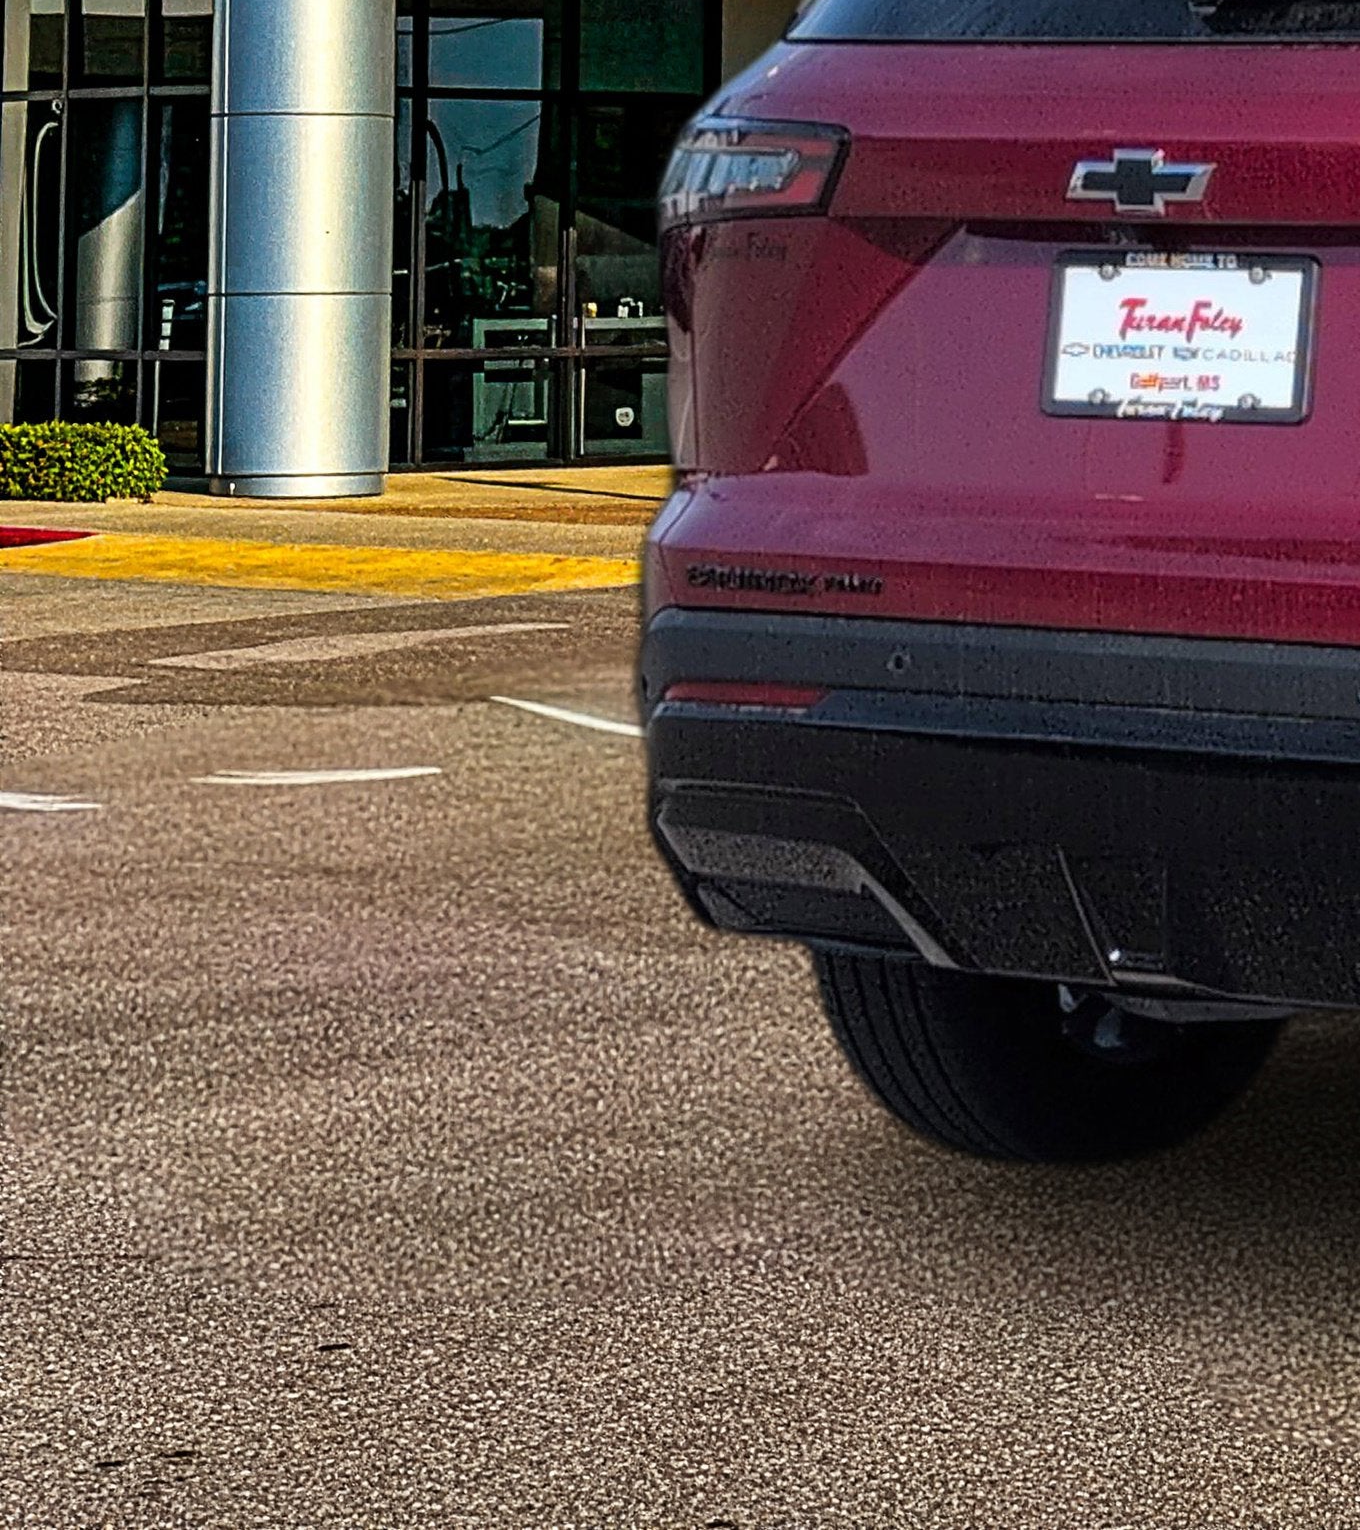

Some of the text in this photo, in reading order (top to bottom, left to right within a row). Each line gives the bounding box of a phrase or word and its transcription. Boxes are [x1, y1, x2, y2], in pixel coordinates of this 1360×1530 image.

[1217, 254, 1238, 269] TO
[1119, 298, 1244, 343] Turan Foley
[1092, 344, 1297, 363] CHEVROLET CADILLAC
[1196, 375, 1221, 391] MS
